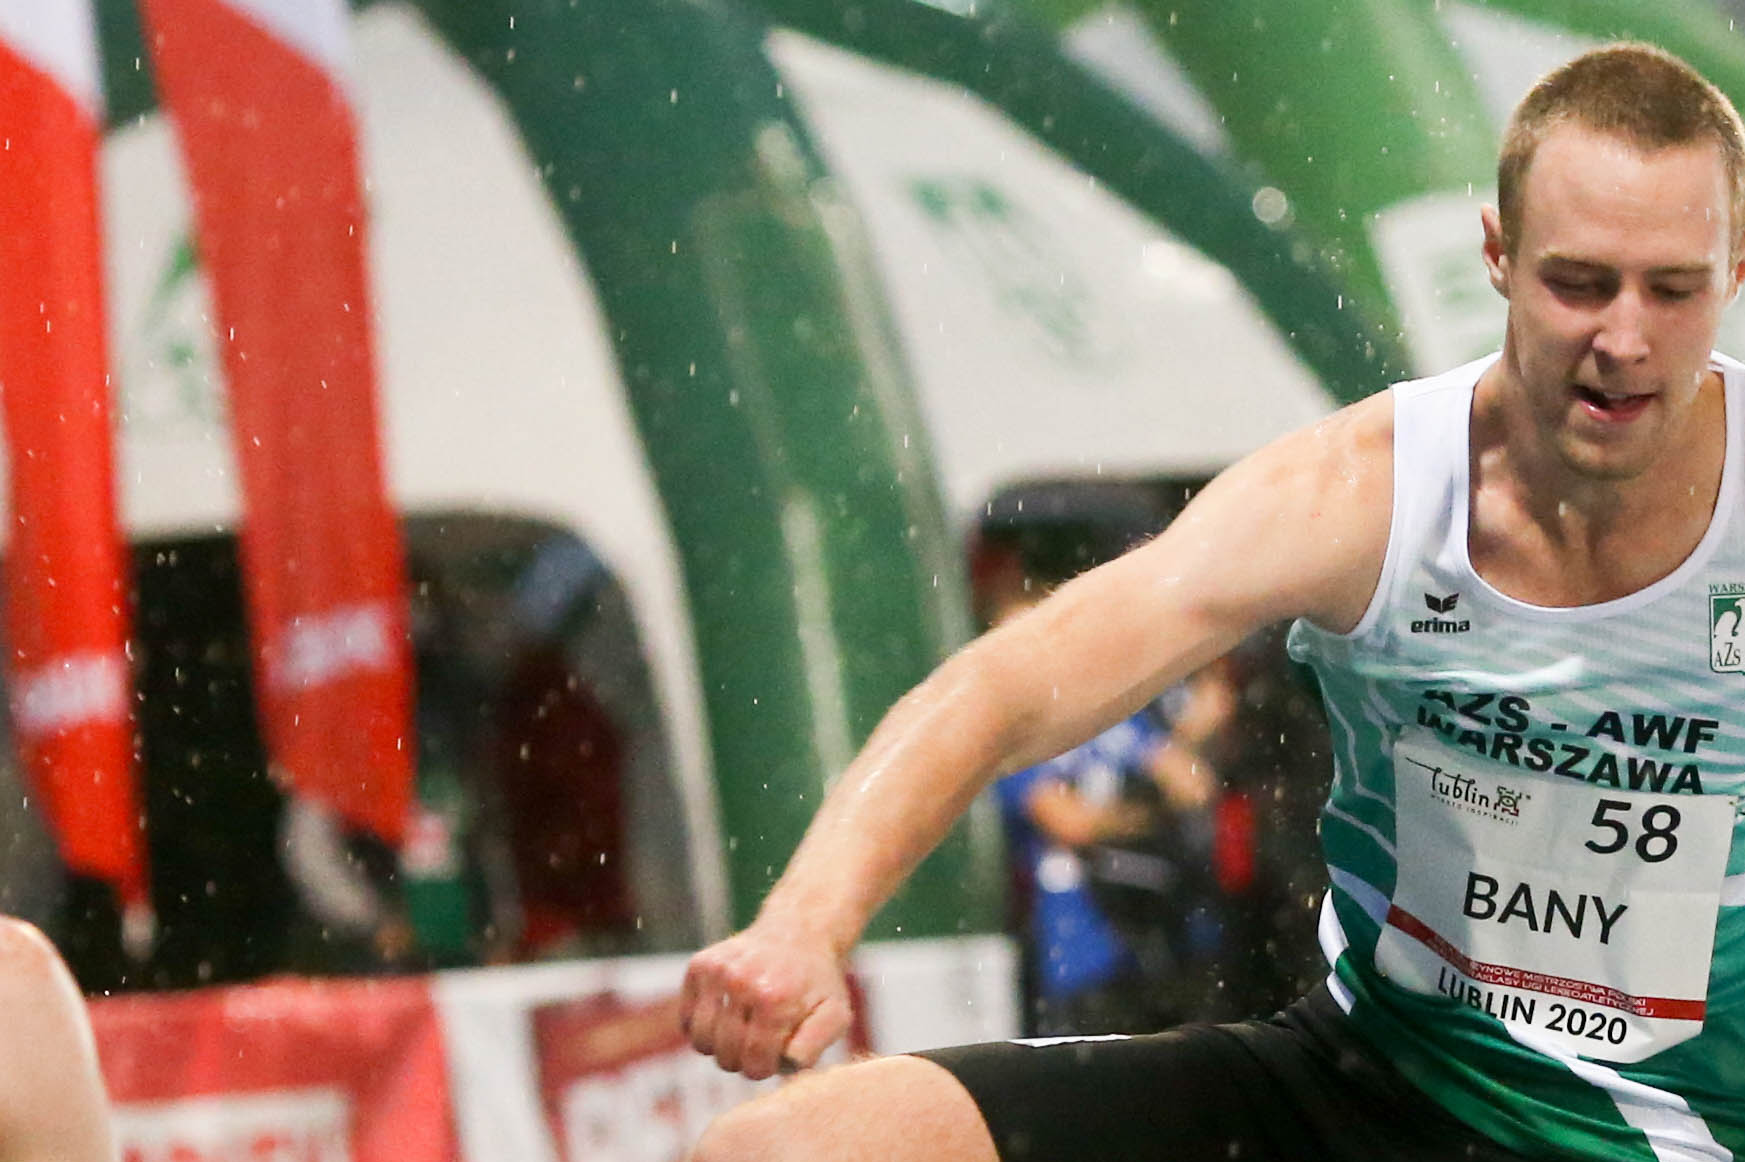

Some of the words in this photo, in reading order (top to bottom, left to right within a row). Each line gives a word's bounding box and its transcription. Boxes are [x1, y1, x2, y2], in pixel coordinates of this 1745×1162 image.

[1411, 617, 1470, 633] erima
[1417, 705, 1704, 795] WARSZAWA
[1424, 689, 1530, 733] AZS
[1586, 711, 1719, 754] AWF
[1584, 798, 1681, 863] 58
[1463, 871, 1628, 945] BANY
[1438, 966, 1536, 1025] LUBLIN
[1545, 1003, 1627, 1045] 2020
